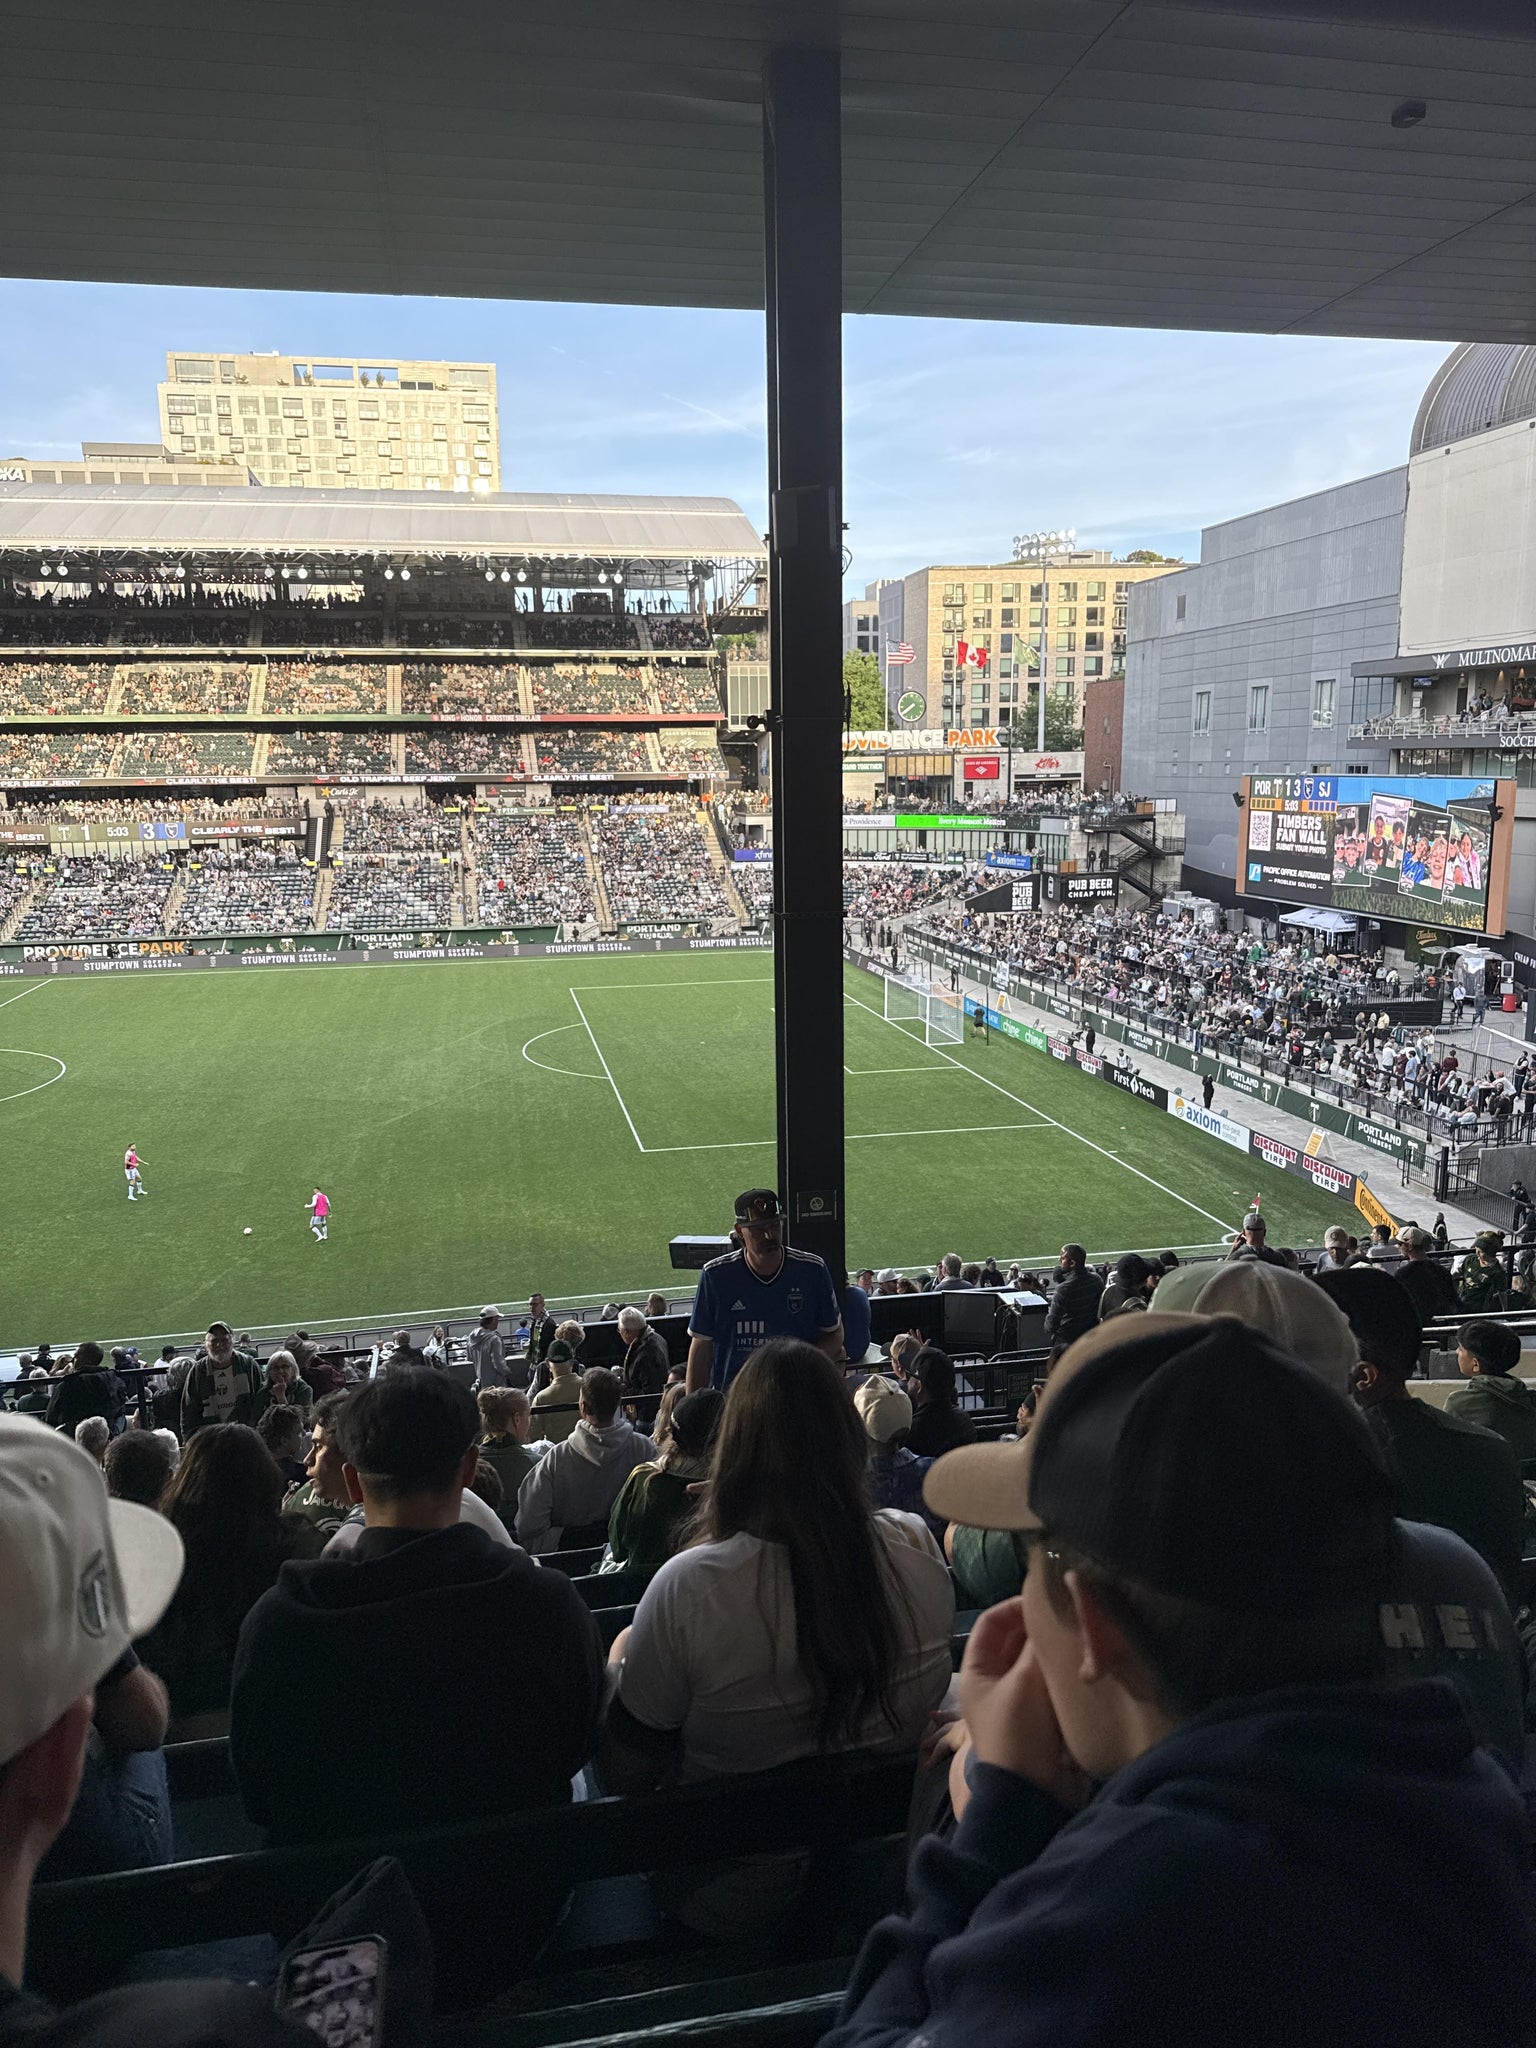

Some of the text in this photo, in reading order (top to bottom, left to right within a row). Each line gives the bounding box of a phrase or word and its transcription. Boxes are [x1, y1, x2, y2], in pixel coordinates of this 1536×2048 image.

[948, 726, 1002, 749] PARK
[1500, 735, 1536, 748] SOCCE
[49, 779, 81, 787] JERKY
[165, 777, 208, 785] CLEARLY
[209, 777, 227, 785] THE
[1254, 779, 1331, 797] POR 1 3 SJ
[1284, 800, 1298, 811] 5:03
[849, 817, 882, 825] Providence
[1277, 814, 1322, 830] TIMBERS
[80, 825, 91, 841] 1
[106, 827, 129, 837] 5:03
[143, 823, 155, 840] 3
[191, 826, 239, 835] CLEARLY
[240, 825, 263, 834] THE
[1276, 828, 1327, 845] FAN WALL
[1295, 845, 1308, 853] YOUR
[1309, 846, 1327, 855] PHOTO
[997, 854, 1016, 865] axiom
[1262, 865, 1331, 881] PACIFIC OFFICE AUTOMATION
[1012, 886, 1033, 897] PUB
[1068, 878, 1113, 890] PUB BEER
[1012, 897, 1032, 906] BEER
[626, 923, 681, 934] PORTLAND
[353, 933, 414, 944] PORTLAND
[689, 938, 738, 948] STUMPTOWN
[138, 941, 186, 956] PARK
[393, 949, 445, 959] STUMPTOWN
[545, 943, 594, 953] STUMPTOWN
[84, 961, 140, 971] STUMPTOWN
[241, 954, 296, 965] STUMPTOWN
[1002, 1018, 1021, 1038] chime
[1024, 1029, 1044, 1049] chime
[1128, 1031, 1153, 1047] PORTLAND
[1048, 1037, 1072, 1057] DISCOUNT
[1076, 1050, 1103, 1070] DISCOUNT
[1113, 1069, 1155, 1100] First Tech
[1226, 1069, 1259, 1089] PORTLAND
[1186, 1105, 1221, 1135] axiom
[1358, 1121, 1402, 1146] PORTLAND
[1253, 1132, 1298, 1164] DISCOUNT
[1366, 1135, 1392, 1151] TIMBERS
[1264, 1152, 1284, 1167] TIRE
[1302, 1155, 1352, 1189] DISCOUNT
[1315, 1174, 1336, 1190] TIRE
